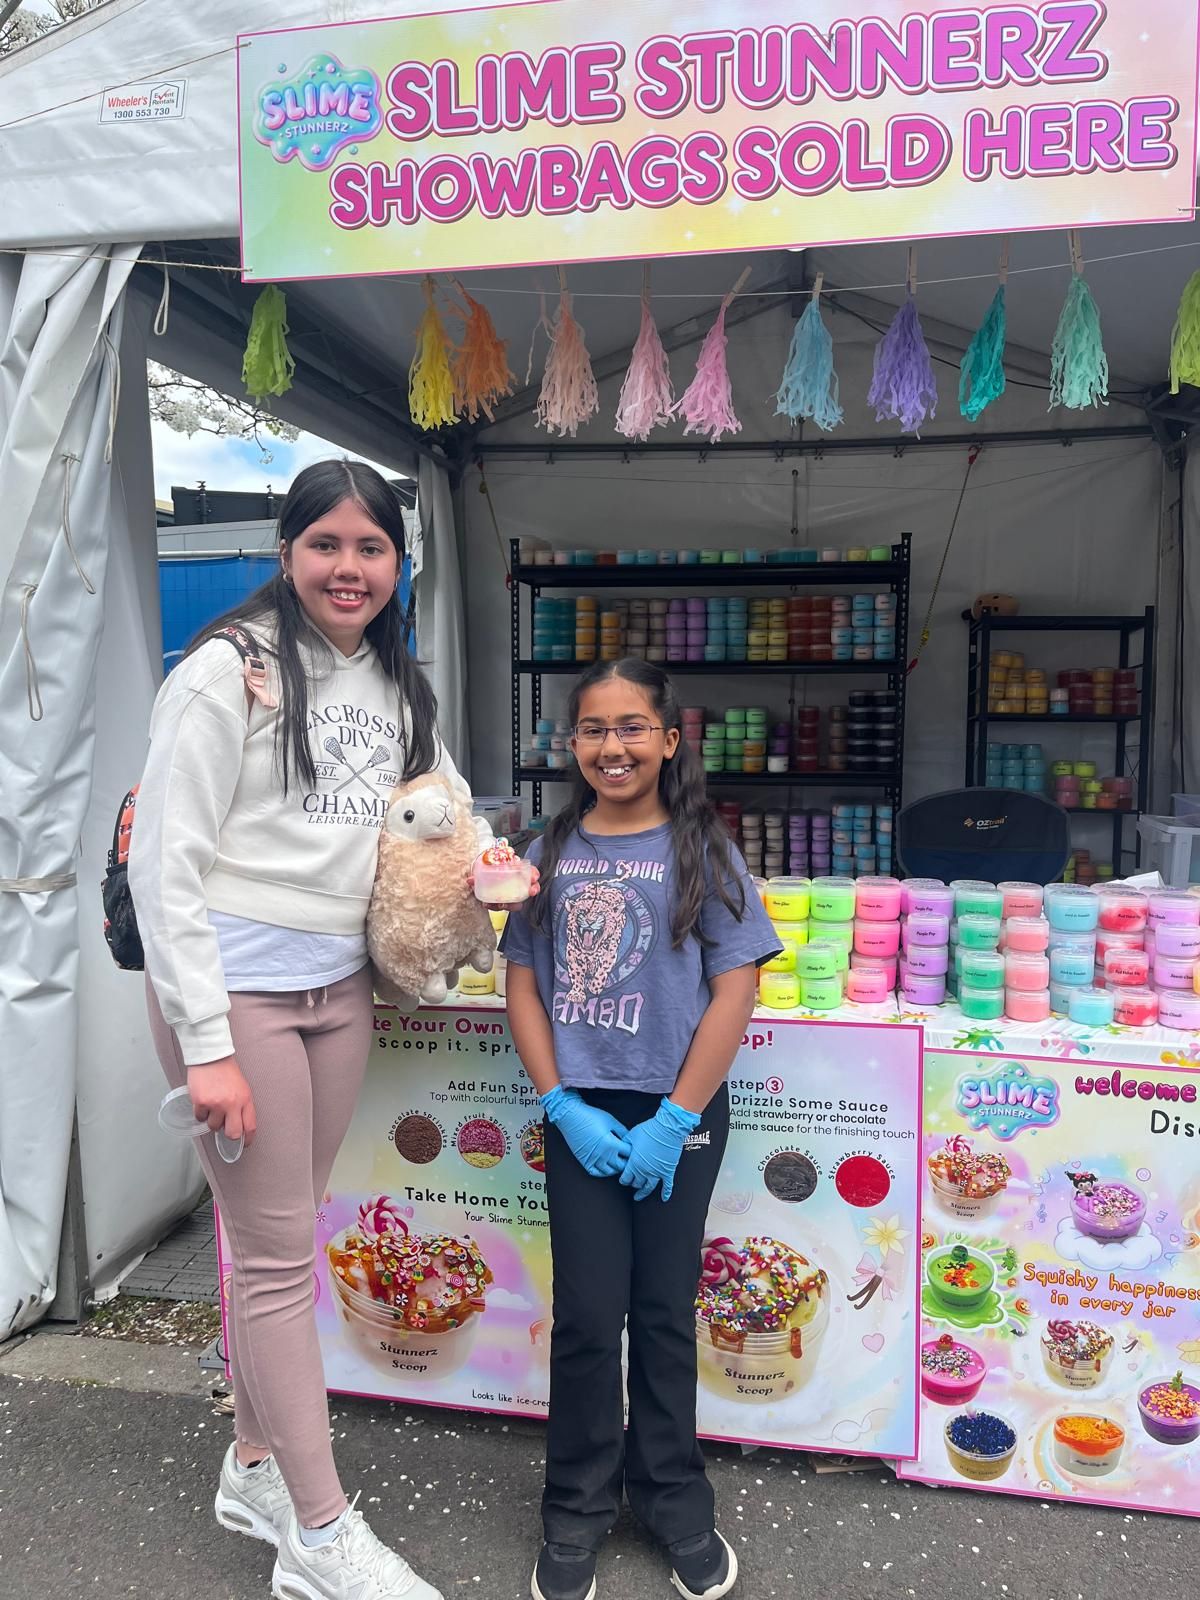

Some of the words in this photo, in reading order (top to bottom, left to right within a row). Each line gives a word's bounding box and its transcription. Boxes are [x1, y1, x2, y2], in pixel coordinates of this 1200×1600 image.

[386, 42, 625, 141] SLIME
[635, 0, 1109, 118] STUNNERZ
[108, 96, 148, 108] Wheeler's
[263, 82, 373, 130] SLIME
[113, 110, 133, 119] 1300
[135, 109, 151, 117] 553
[154, 107, 170, 116] 730
[285, 121, 349, 138] STUNNERZ
[329, 130, 728, 230] SHOWBAGS
[732, 112, 953, 198] SOLD
[963, 95, 1180, 183] HERE
[338, 726, 374, 749] DIV.
[377, 772, 397, 786] 1984
[308, 815, 359, 826] LEISURE
[552, 991, 644, 1036] AMBO
[399, 1016, 447, 1033] Your
[455, 1017, 504, 1035] Own
[378, 1037, 437, 1054] Scoop
[448, 1038, 469, 1052] it.
[479, 1041, 518, 1056] Spr
[448, 1081, 475, 1092] Add
[481, 1082, 506, 1093] Fun
[730, 1079, 765, 1093] step
[1075, 1069, 1197, 1103] welcome
[430, 1092, 448, 1103] Top
[450, 1093, 471, 1103] with
[473, 1094, 517, 1105] colourful
[519, 1097, 541, 1108] spri
[731, 1094, 783, 1107] Drizzle
[789, 1097, 833, 1110] Some
[838, 1100, 889, 1113] Sauce
[961, 1081, 1053, 1115] SLIME
[729, 1107, 750, 1118] Add
[753, 1109, 814, 1123] strawberry
[815, 1112, 828, 1122] or
[829, 1113, 886, 1125] chocolate
[978, 1107, 1032, 1120] STUNNERZ
[1151, 1109, 1200, 1137] Dis
[388, 1109, 419, 1141] Chocolate
[423, 1111, 448, 1149] sprinkles
[451, 1122, 464, 1147] Mixed
[464, 1112, 486, 1122] fruit
[489, 1116, 513, 1155] sprinkles
[515, 1118, 538, 1139] Candy
[728, 1121, 759, 1131] slime
[761, 1123, 794, 1133] sauce
[796, 1124, 811, 1134] for
[814, 1125, 832, 1135] the
[834, 1126, 880, 1140] finishing
[882, 1129, 916, 1140] touch
[757, 1145, 801, 1172] Chocolate
[803, 1149, 823, 1176] Sauce
[828, 1150, 873, 1180] Strawberry
[876, 1153, 896, 1180] Sauce
[404, 1187, 447, 1203] Take
[455, 1191, 509, 1208] Home
[464, 1211, 485, 1222] Your
[488, 1212, 513, 1225] Slime
[1023, 1262, 1098, 1291] Squishy
[1051, 1289, 1069, 1306] in
[1080, 1296, 1133, 1316] every
[1143, 1300, 1176, 1319] jar
[380, 1341, 438, 1357] Stunnerz
[392, 1359, 428, 1373] Scoop
[724, 1367, 786, 1381] Stunnerz
[472, 1388, 495, 1401] Looks
[498, 1392, 513, 1403] like
[736, 1384, 774, 1397] Scoop
